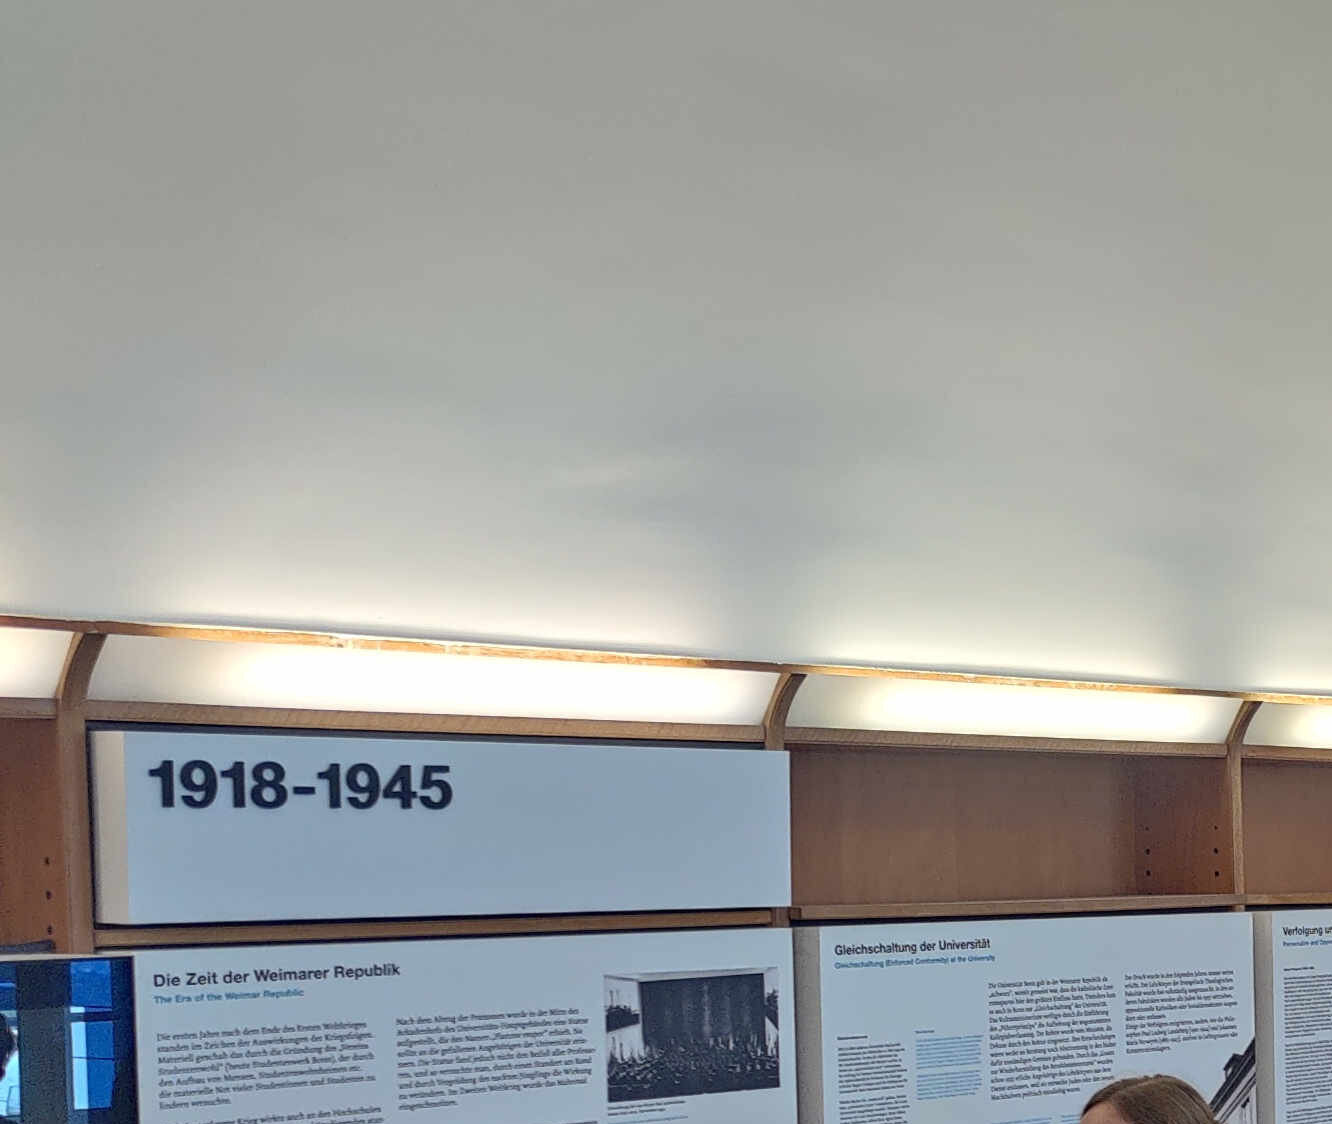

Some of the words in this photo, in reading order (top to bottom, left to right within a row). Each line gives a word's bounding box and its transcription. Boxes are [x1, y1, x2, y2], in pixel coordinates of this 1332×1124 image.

[1283, 926, 1322, 937] Verfolgung
[835, 943, 916, 956] Gleichschaltung
[920, 941, 935, 952] der
[939, 938, 990, 950] Universität
[153, 974, 180, 987] Die
[186, 972, 218, 986] Zeit
[223, 970, 250, 984] der
[254, 967, 329, 982] Weimarer
[334, 963, 400, 979] Republik
[154, 995, 172, 1004] The
[207, 992, 222, 1001] the
[264, 988, 304, 1000] Republic
